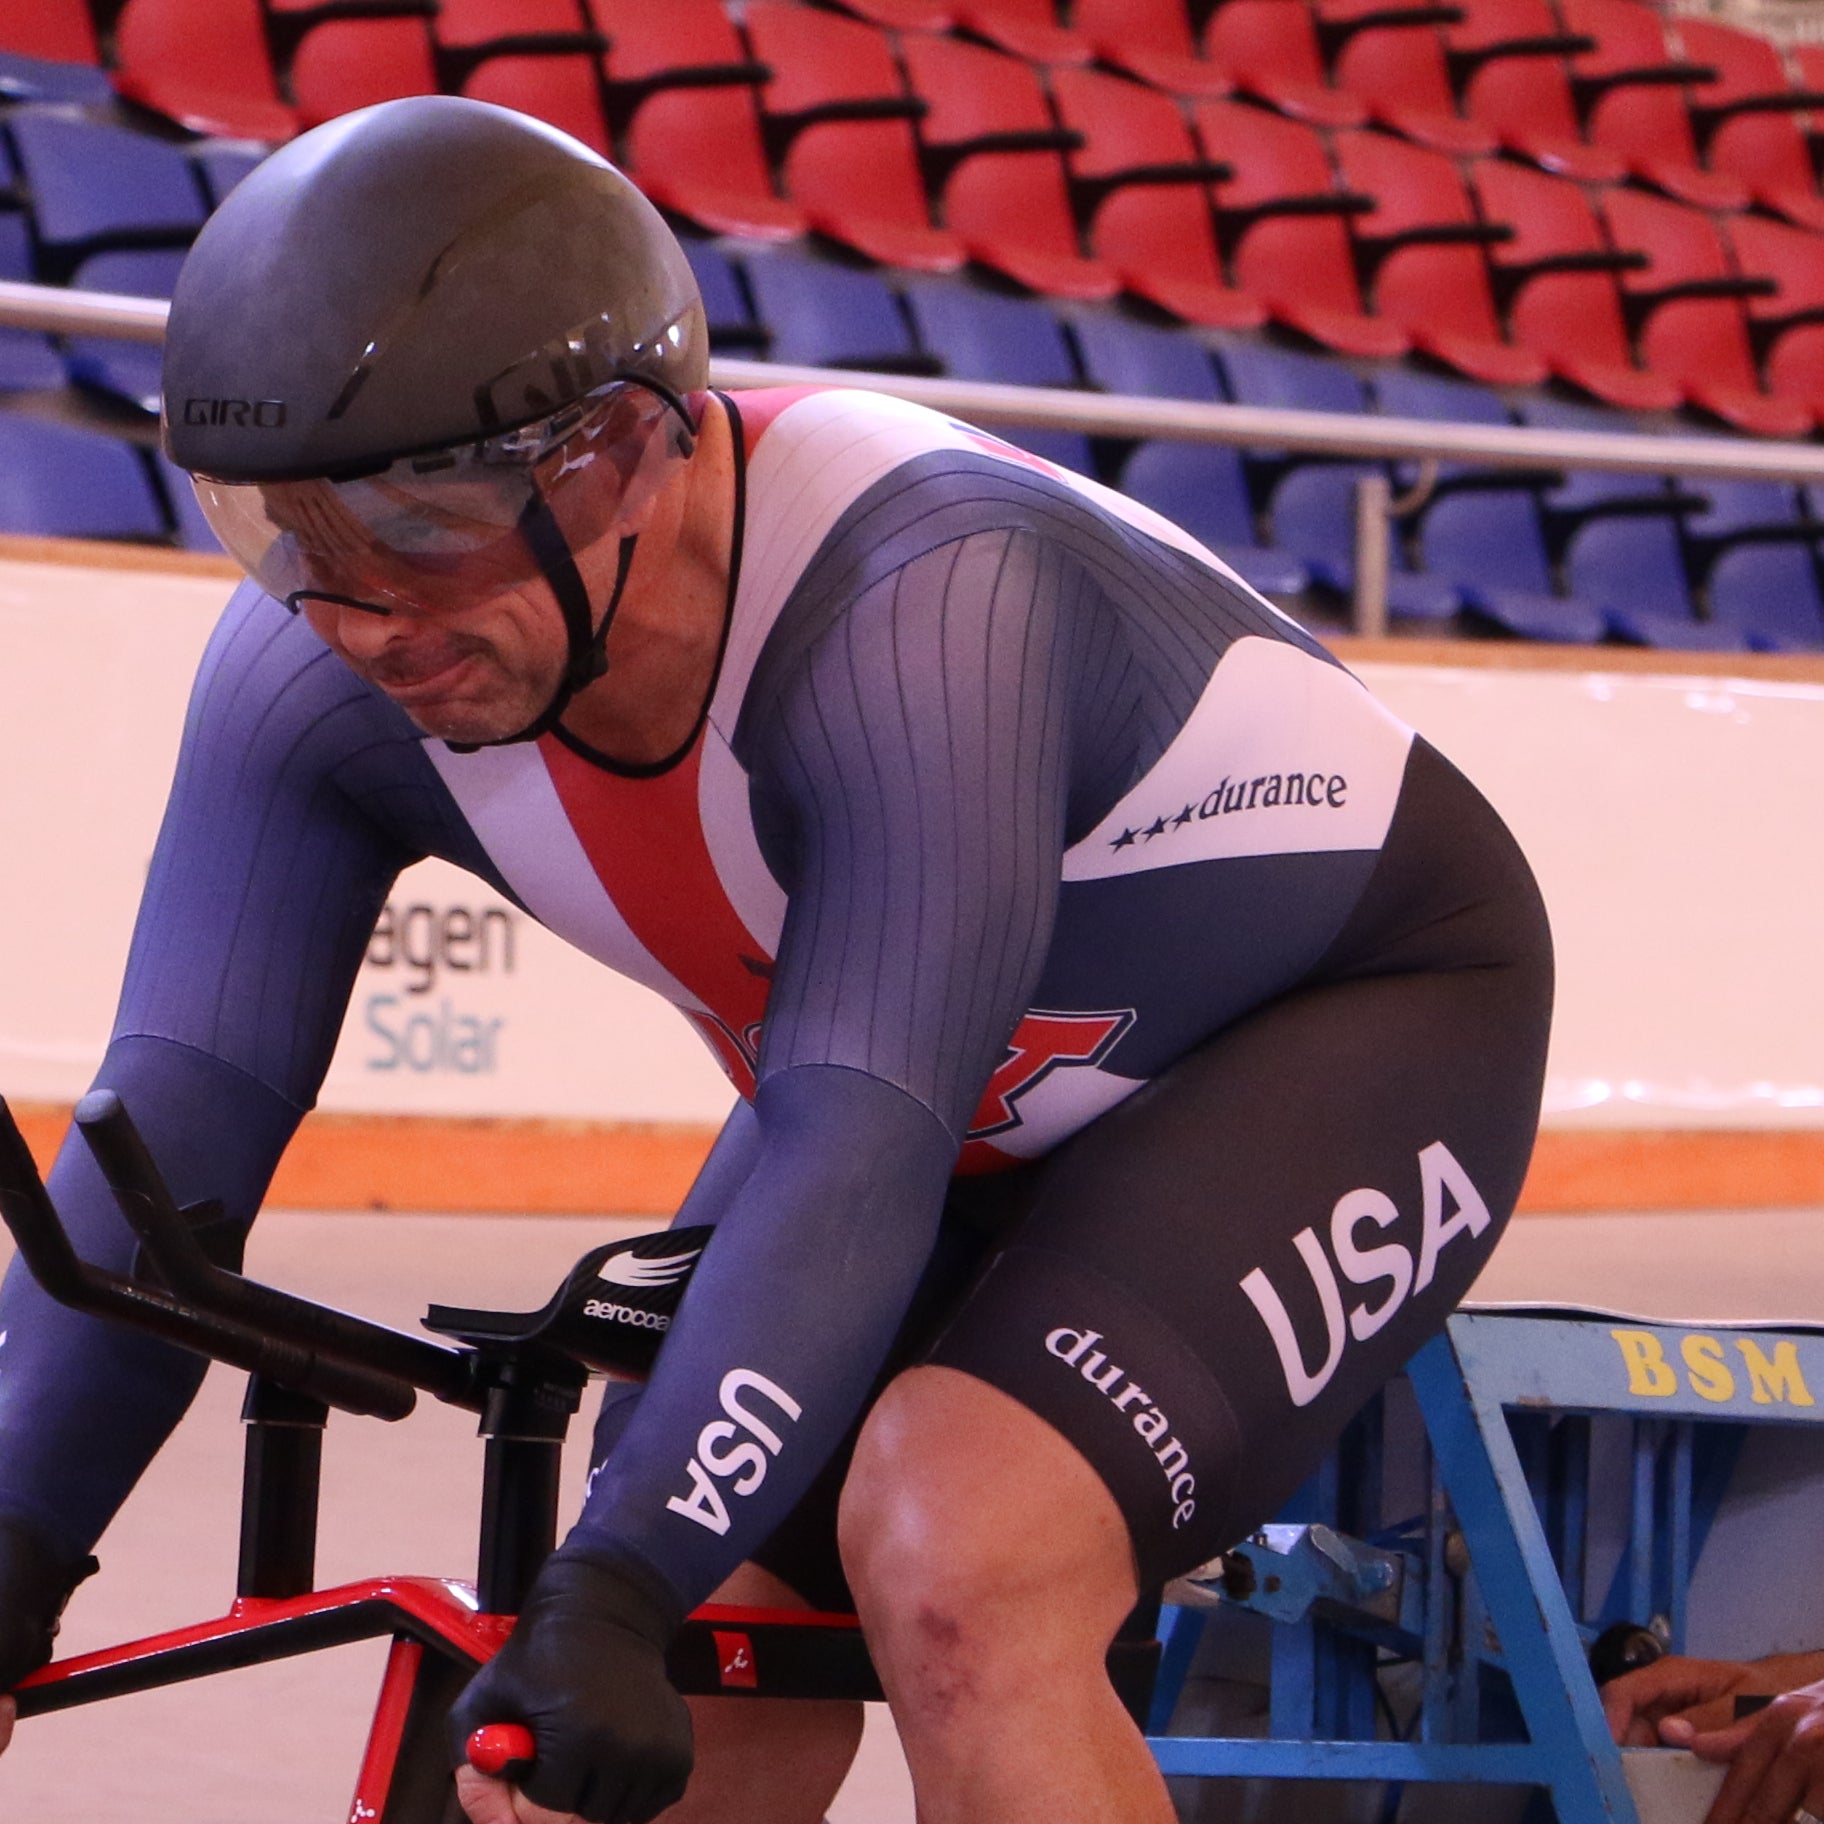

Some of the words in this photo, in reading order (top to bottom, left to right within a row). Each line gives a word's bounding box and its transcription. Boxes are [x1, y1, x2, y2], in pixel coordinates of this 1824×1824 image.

[183, 398, 287, 428] GIRO
[1198, 772, 1348, 821] durance
[365, 994, 505, 1074] Solar
[1239, 1141, 1492, 1408] USA
[1610, 1328, 1816, 1407] BSM
[665, 1367, 803, 1537] USA
[1044, 1326, 1197, 1528] durance
